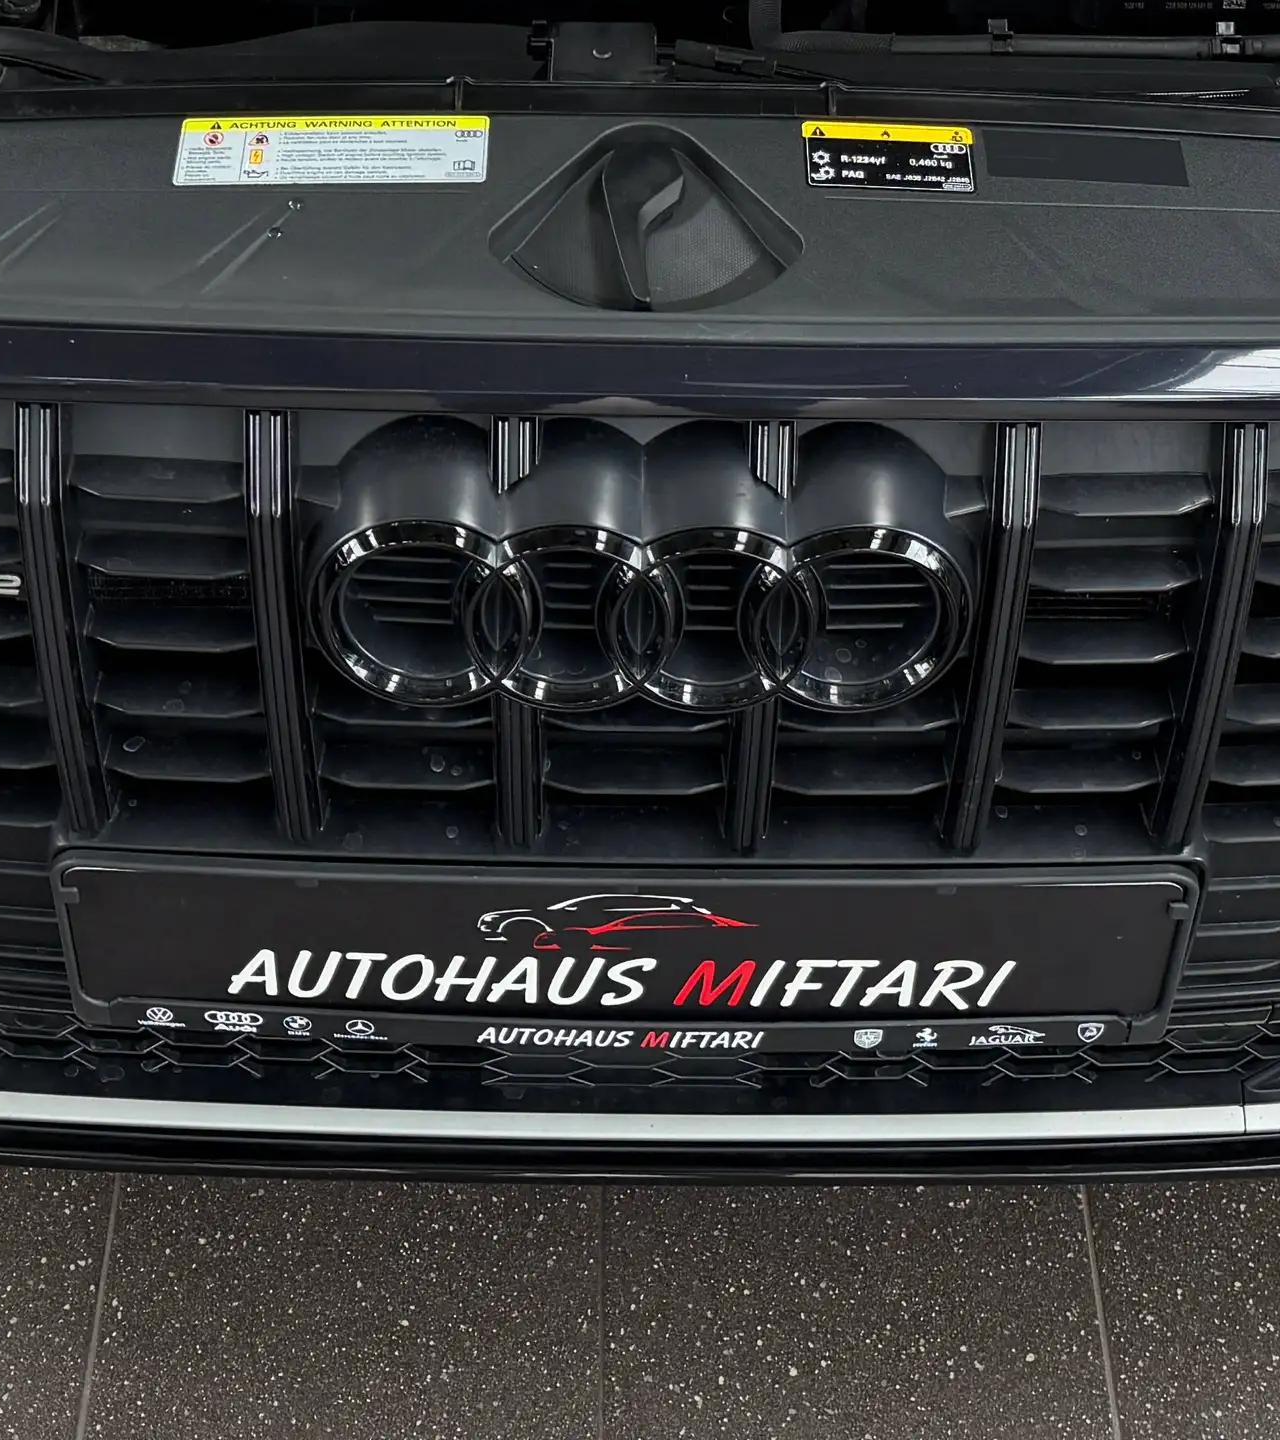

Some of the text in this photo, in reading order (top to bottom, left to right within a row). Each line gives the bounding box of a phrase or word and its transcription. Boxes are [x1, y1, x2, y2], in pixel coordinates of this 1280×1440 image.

[228, 119, 457, 130] ACHTUNG WARNING ATTENTION
[227, 948, 1017, 1011] AUTOHAUS MIFTARI
[477, 1026, 765, 1050] AUTOHAUS MIFTARI
[968, 1034, 1040, 1046] JAGUAR
